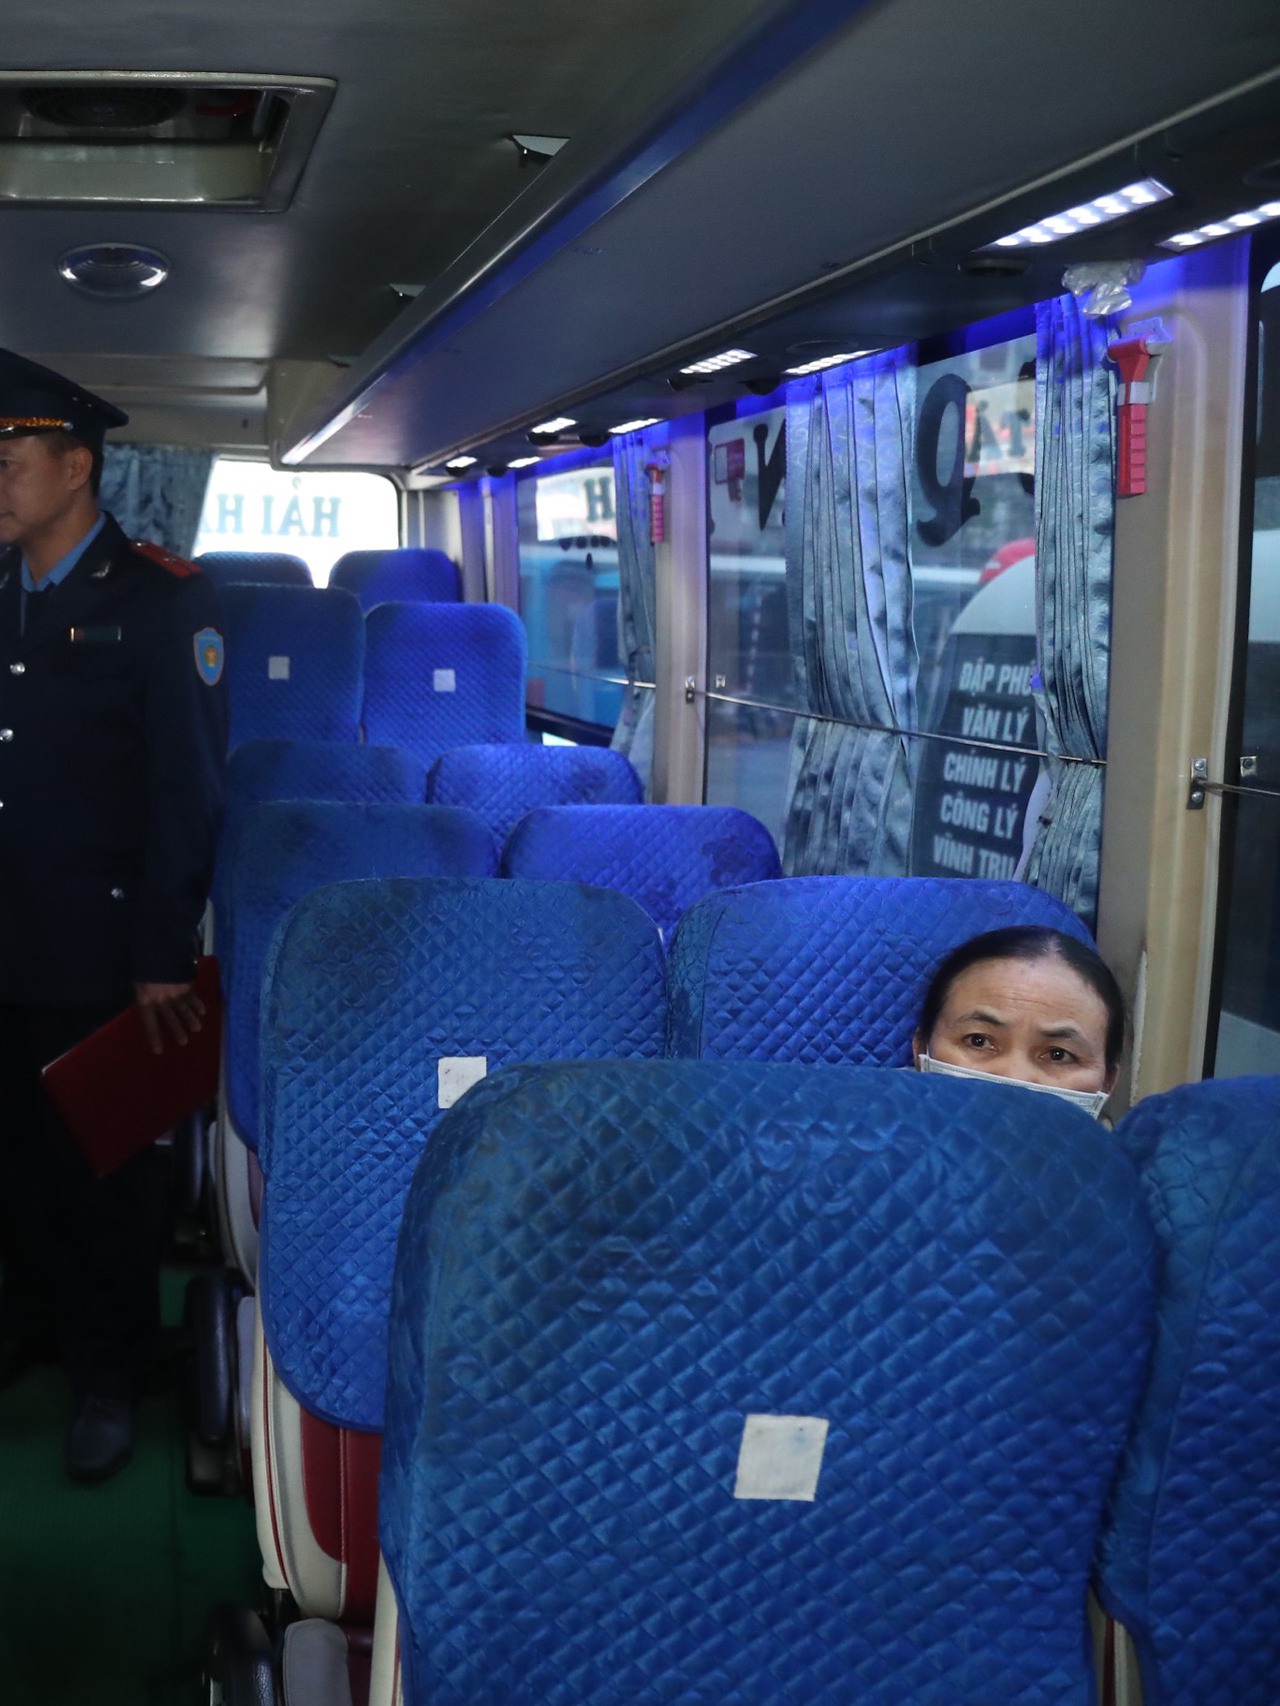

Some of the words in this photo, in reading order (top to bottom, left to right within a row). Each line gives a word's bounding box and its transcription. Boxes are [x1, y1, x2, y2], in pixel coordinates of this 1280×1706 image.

[1002, 706, 1029, 743] LÝ
[943, 748, 998, 789] CHÍNH
[1000, 757, 1027, 794] LÝ
[940, 789, 990, 834] CÔNG
[994, 802, 1019, 840] LÝ
